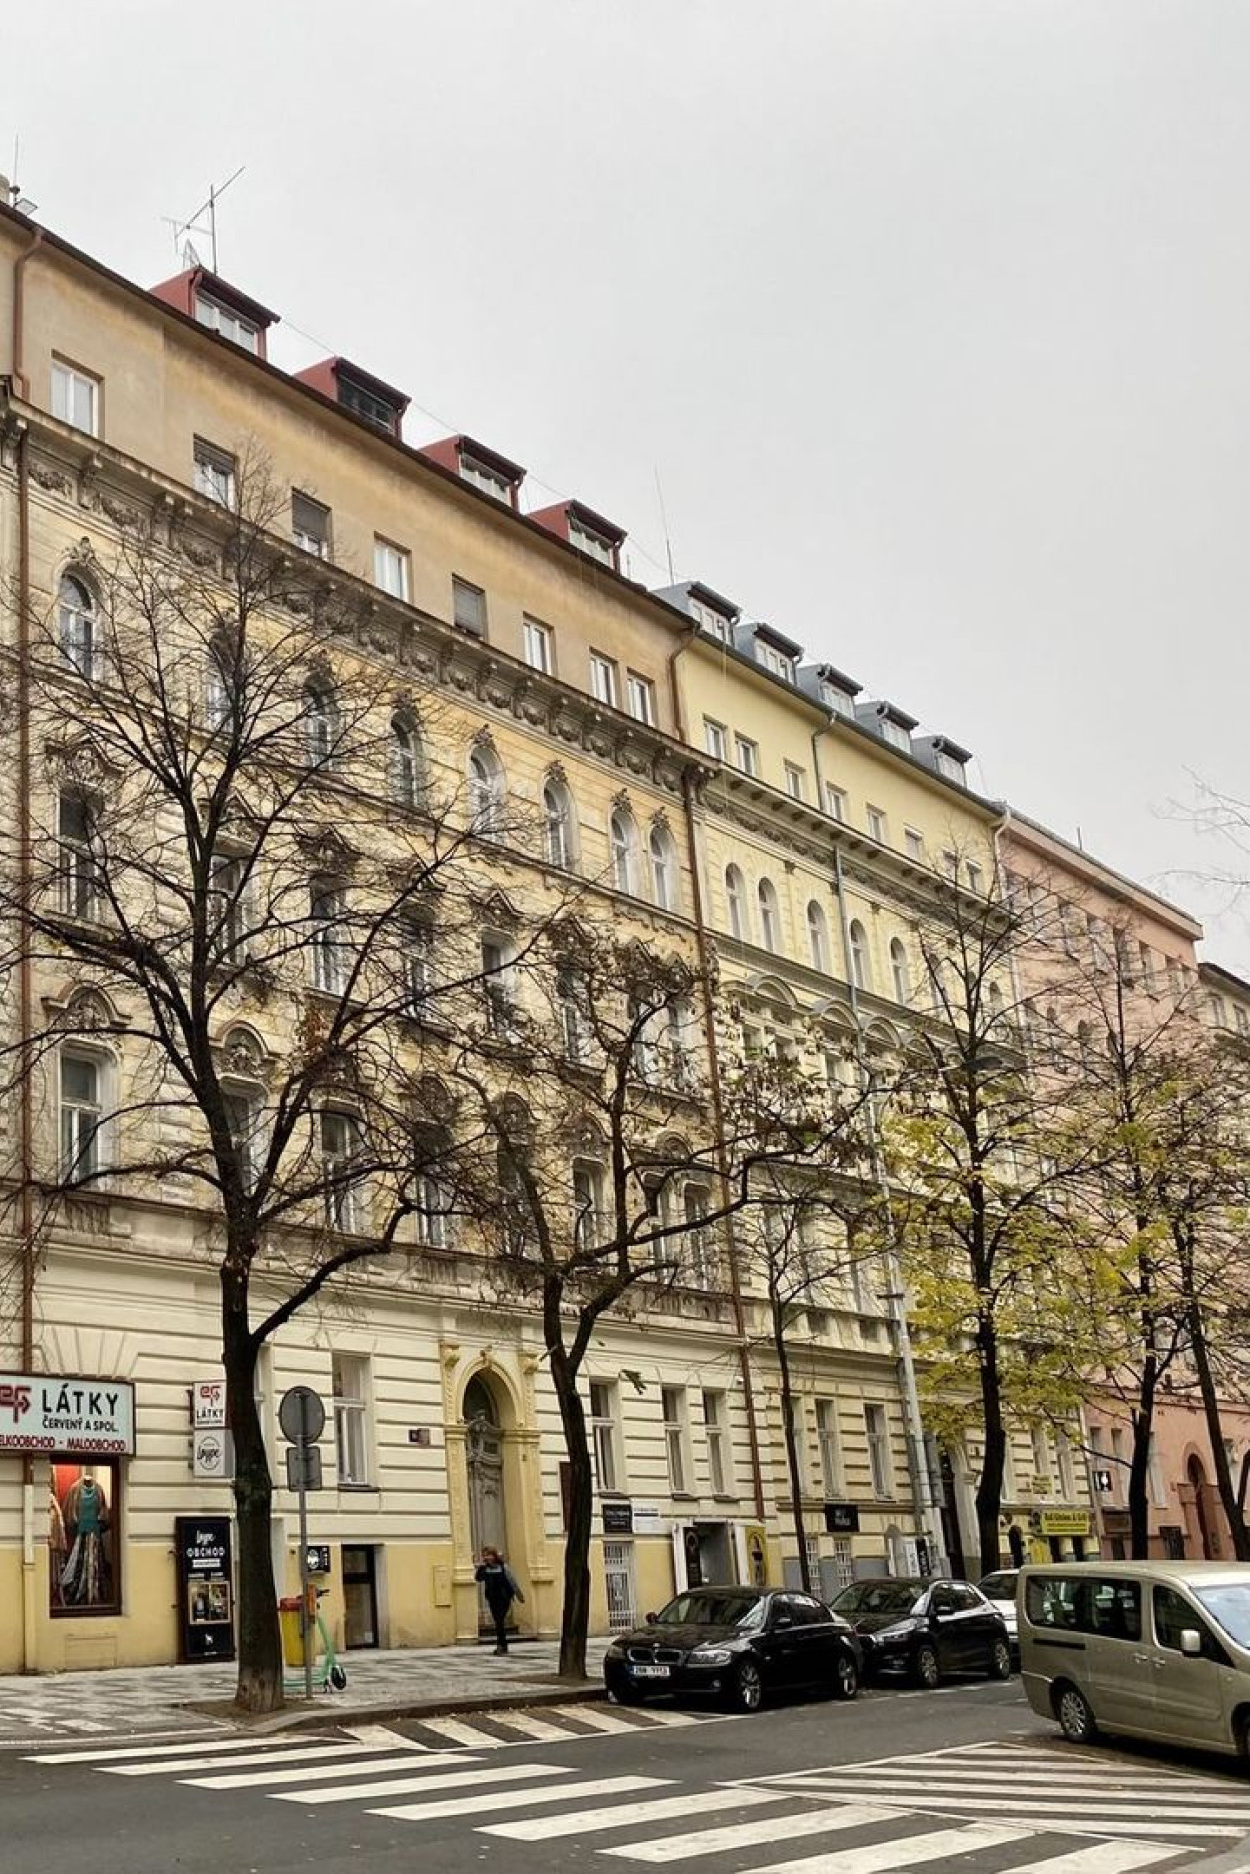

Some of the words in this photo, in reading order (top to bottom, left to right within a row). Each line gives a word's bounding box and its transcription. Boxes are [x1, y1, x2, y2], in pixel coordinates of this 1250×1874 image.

[42, 1383, 118, 1416] LÁTKY
[197, 1407, 223, 1419] LÁTKY
[42, 1414, 83, 1430] ČERVENÝ
[84, 1421, 92, 1431] A
[93, 1421, 119, 1432] SPOL.
[66, 1438, 126, 1451] MALOOBCHOD
[186, 1546, 225, 1557] OBCHOD
